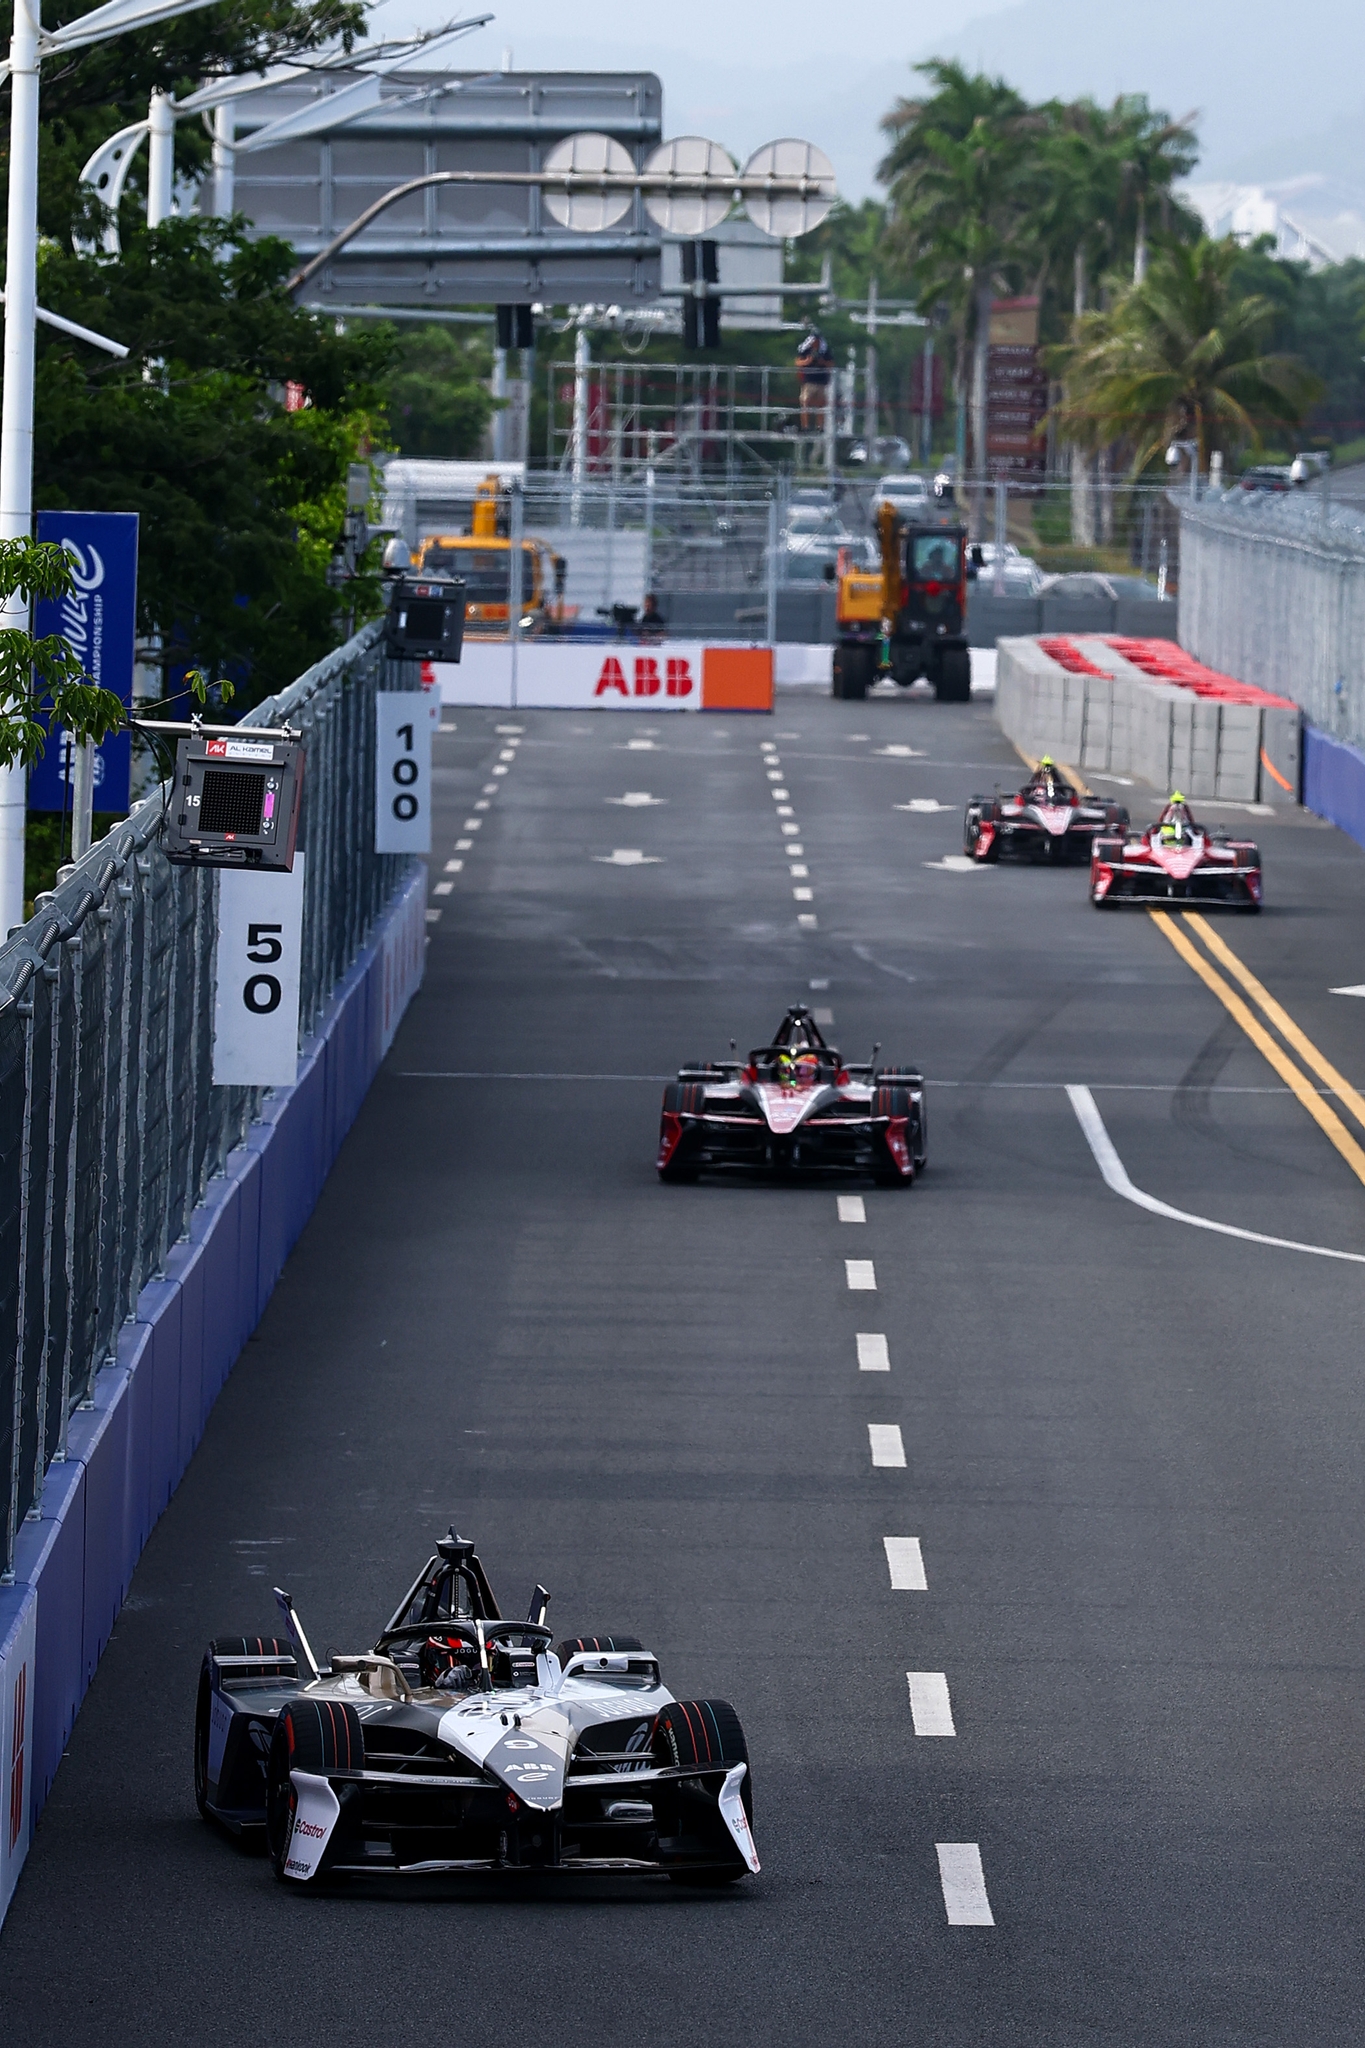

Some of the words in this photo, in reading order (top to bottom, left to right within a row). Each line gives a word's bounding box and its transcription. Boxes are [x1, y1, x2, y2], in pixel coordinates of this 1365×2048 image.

[92, 594, 104, 690] HAMPIONSHIP
[594, 656, 695, 698] ABB
[185, 794, 201, 807] 15
[242, 923, 283, 1015] 50
[503, 1739, 539, 1750] 9
[503, 1762, 557, 1773] ABB
[299, 1820, 328, 1840] Castrol
